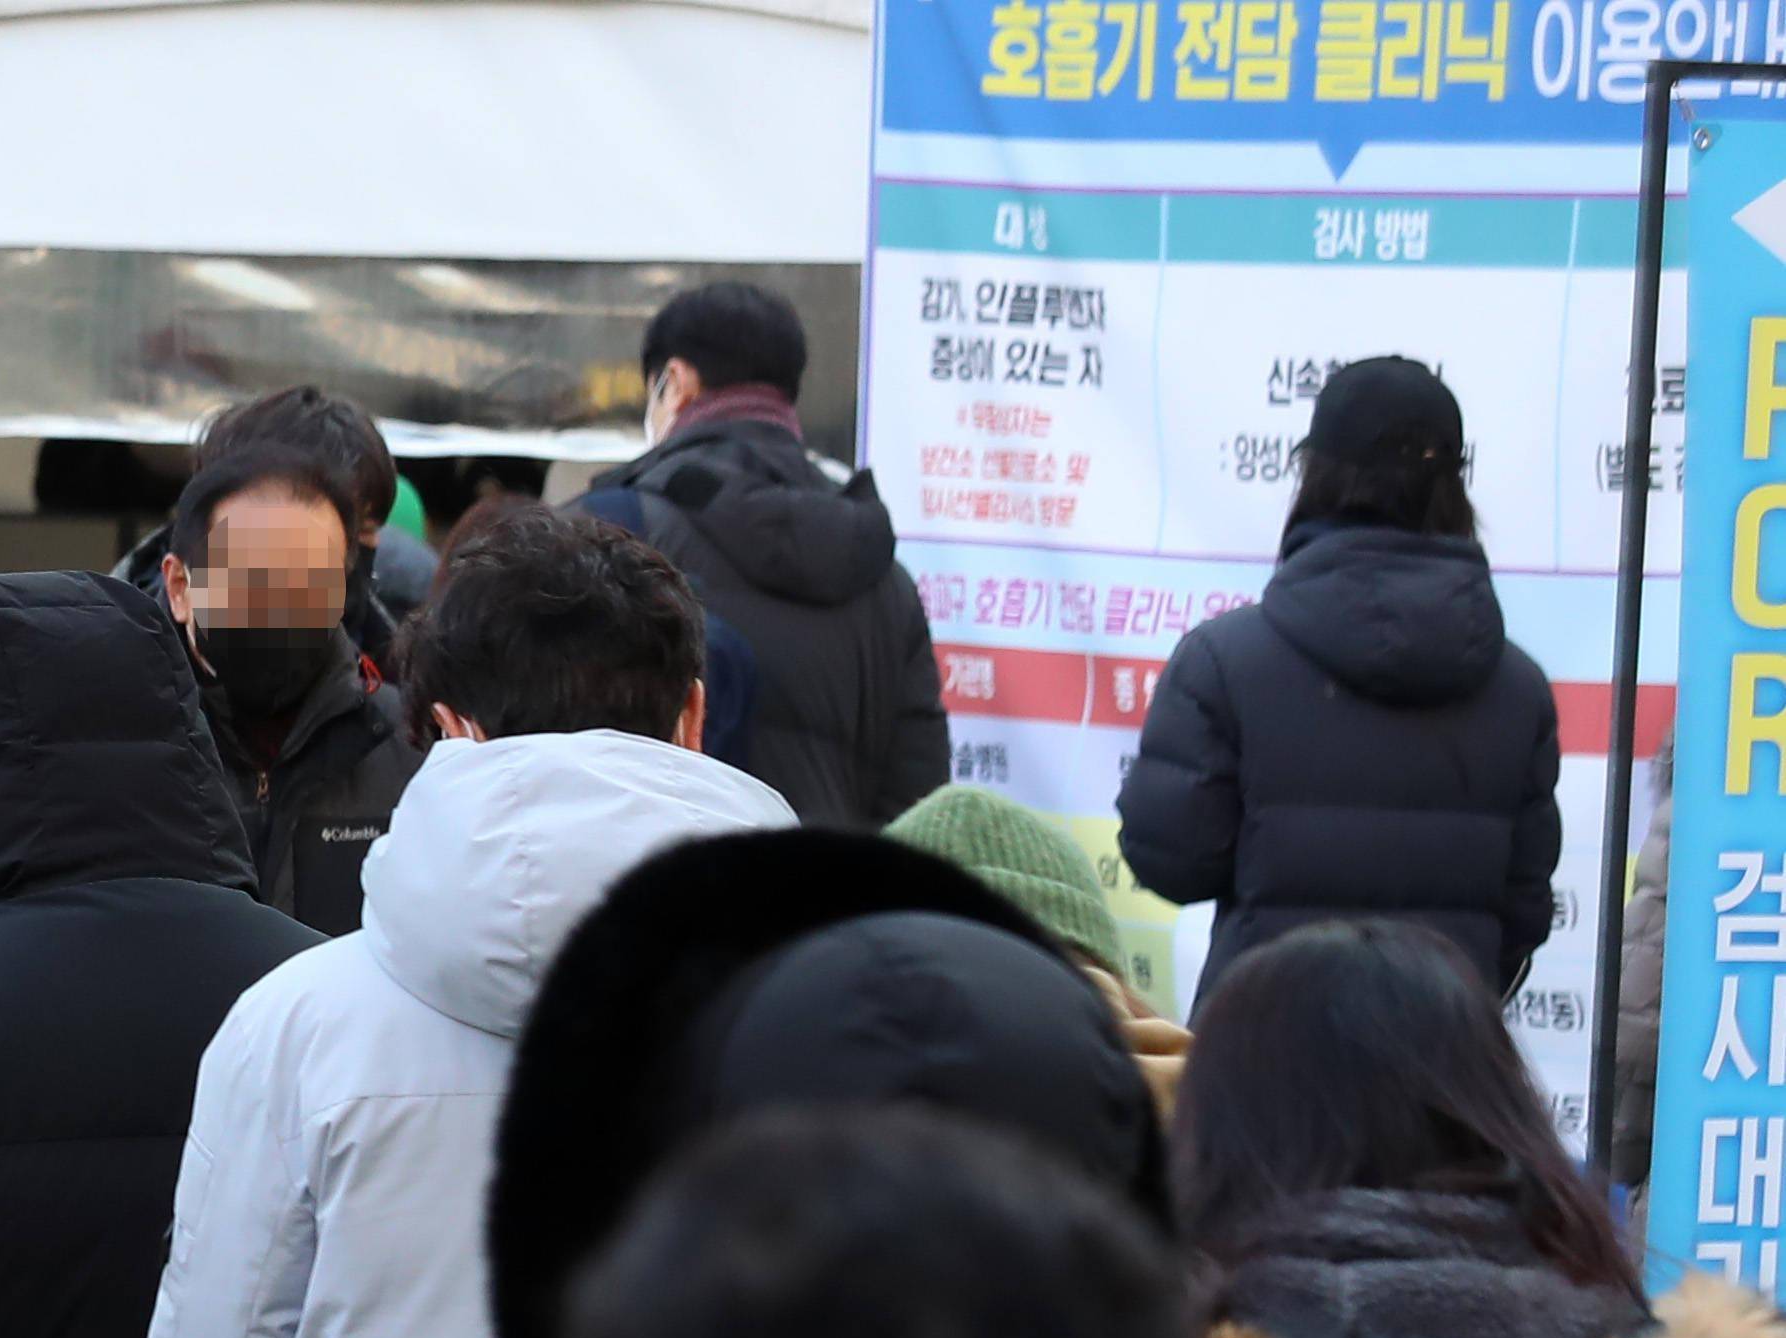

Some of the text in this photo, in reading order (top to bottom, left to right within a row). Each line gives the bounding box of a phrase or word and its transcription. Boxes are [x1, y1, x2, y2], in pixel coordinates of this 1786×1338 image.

[982, 0, 1156, 101] 호흡기
[1173, 0, 1297, 101] 전담
[1313, 0, 1508, 102] 클리닉
[1314, 208, 1429, 261] 검사 방법
[1003, 337, 1069, 387] 있는
[1078, 345, 1103, 389] 자
[973, 577, 1052, 631] 호흡기
[1105, 586, 1193, 635] 클리닉
